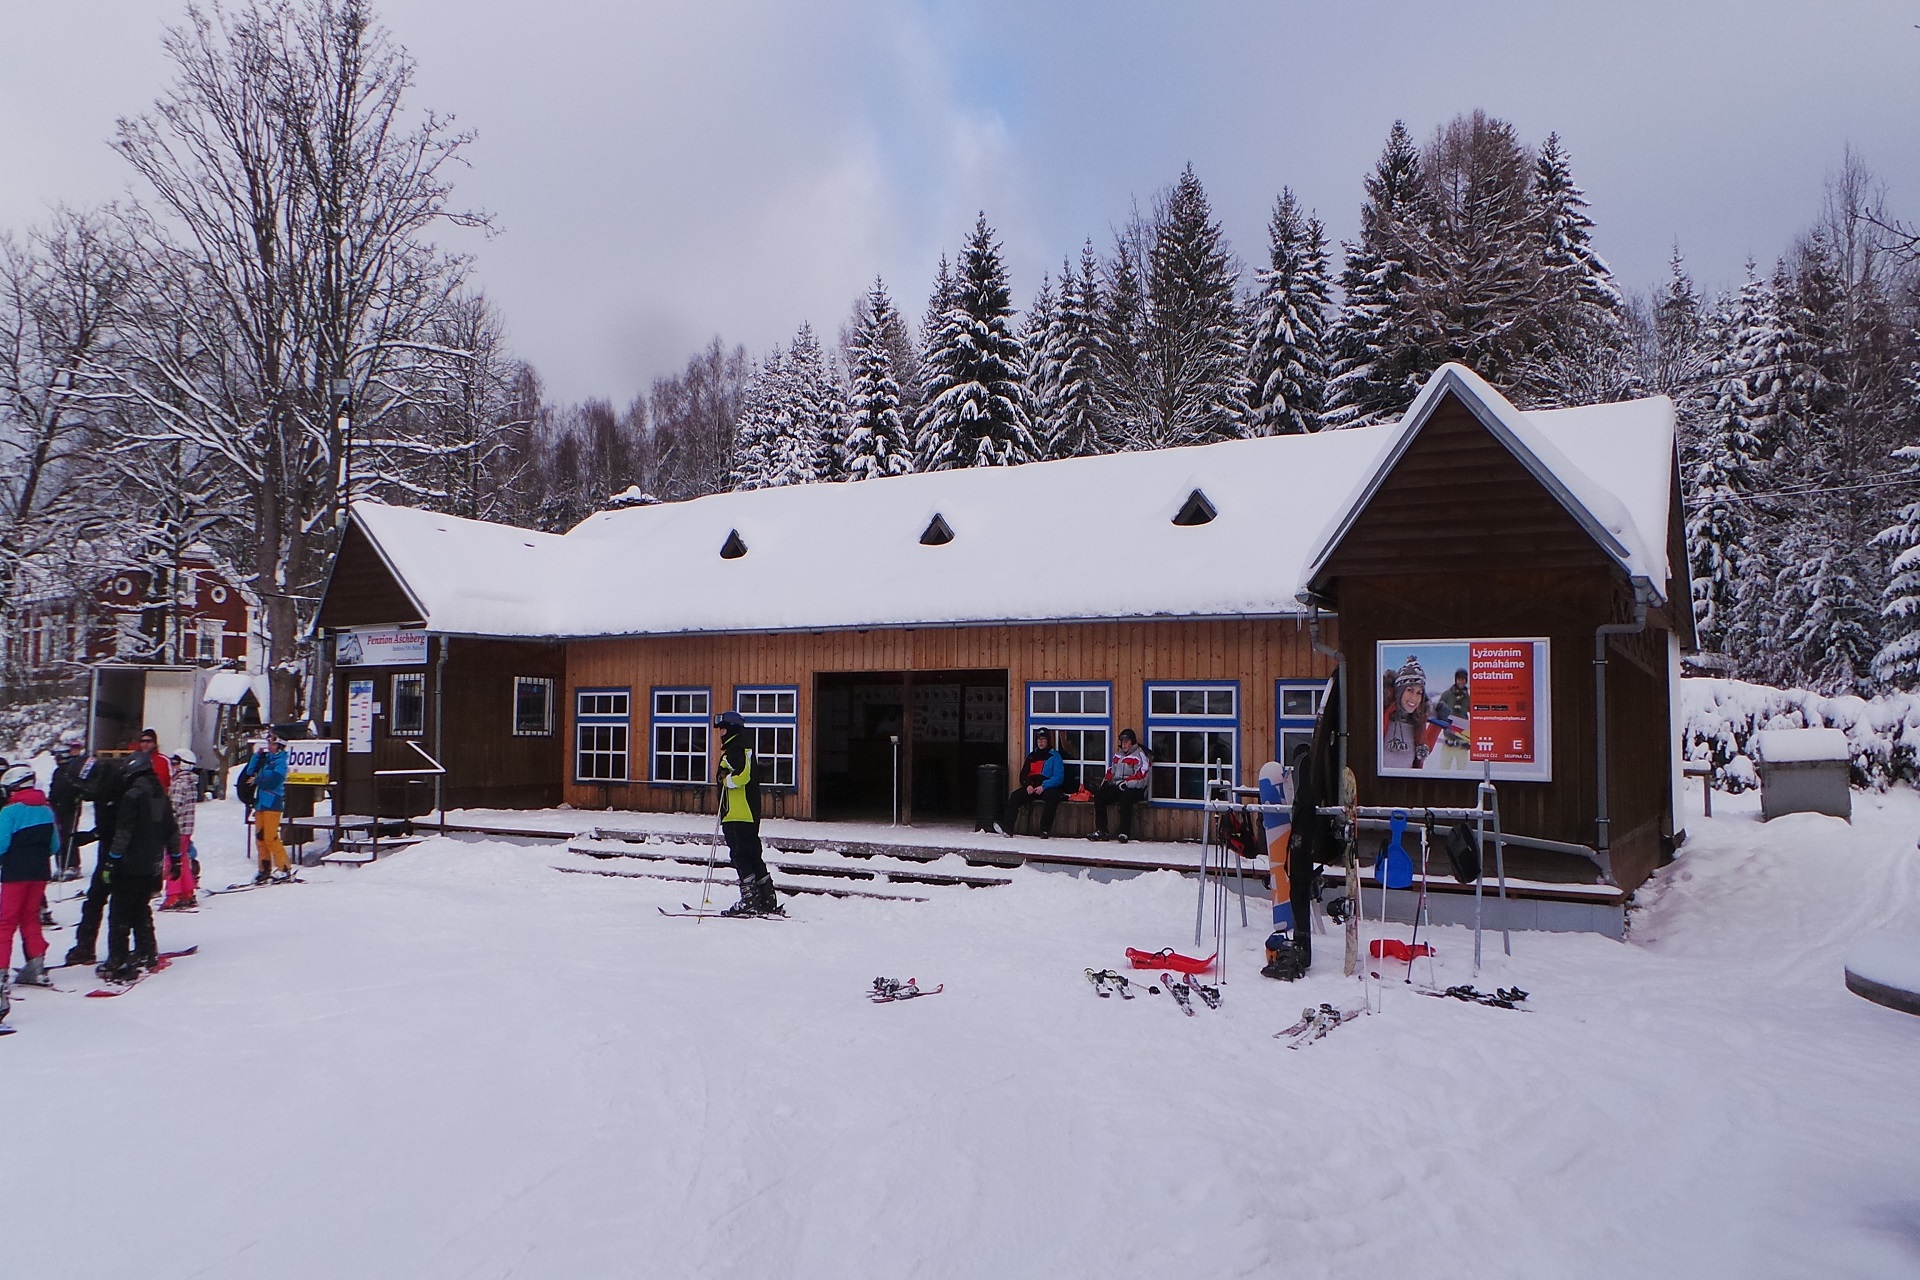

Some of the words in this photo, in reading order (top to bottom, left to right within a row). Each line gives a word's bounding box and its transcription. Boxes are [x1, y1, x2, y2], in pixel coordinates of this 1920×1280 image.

[367, 635, 392, 645] Penzion
[393, 633, 425, 646] Aschberg
[1472, 648, 1522, 658] Lyžováním
[1472, 659, 1525, 670] pomáháme
[1472, 670, 1514, 680] ostatním
[288, 747, 328, 766] board
